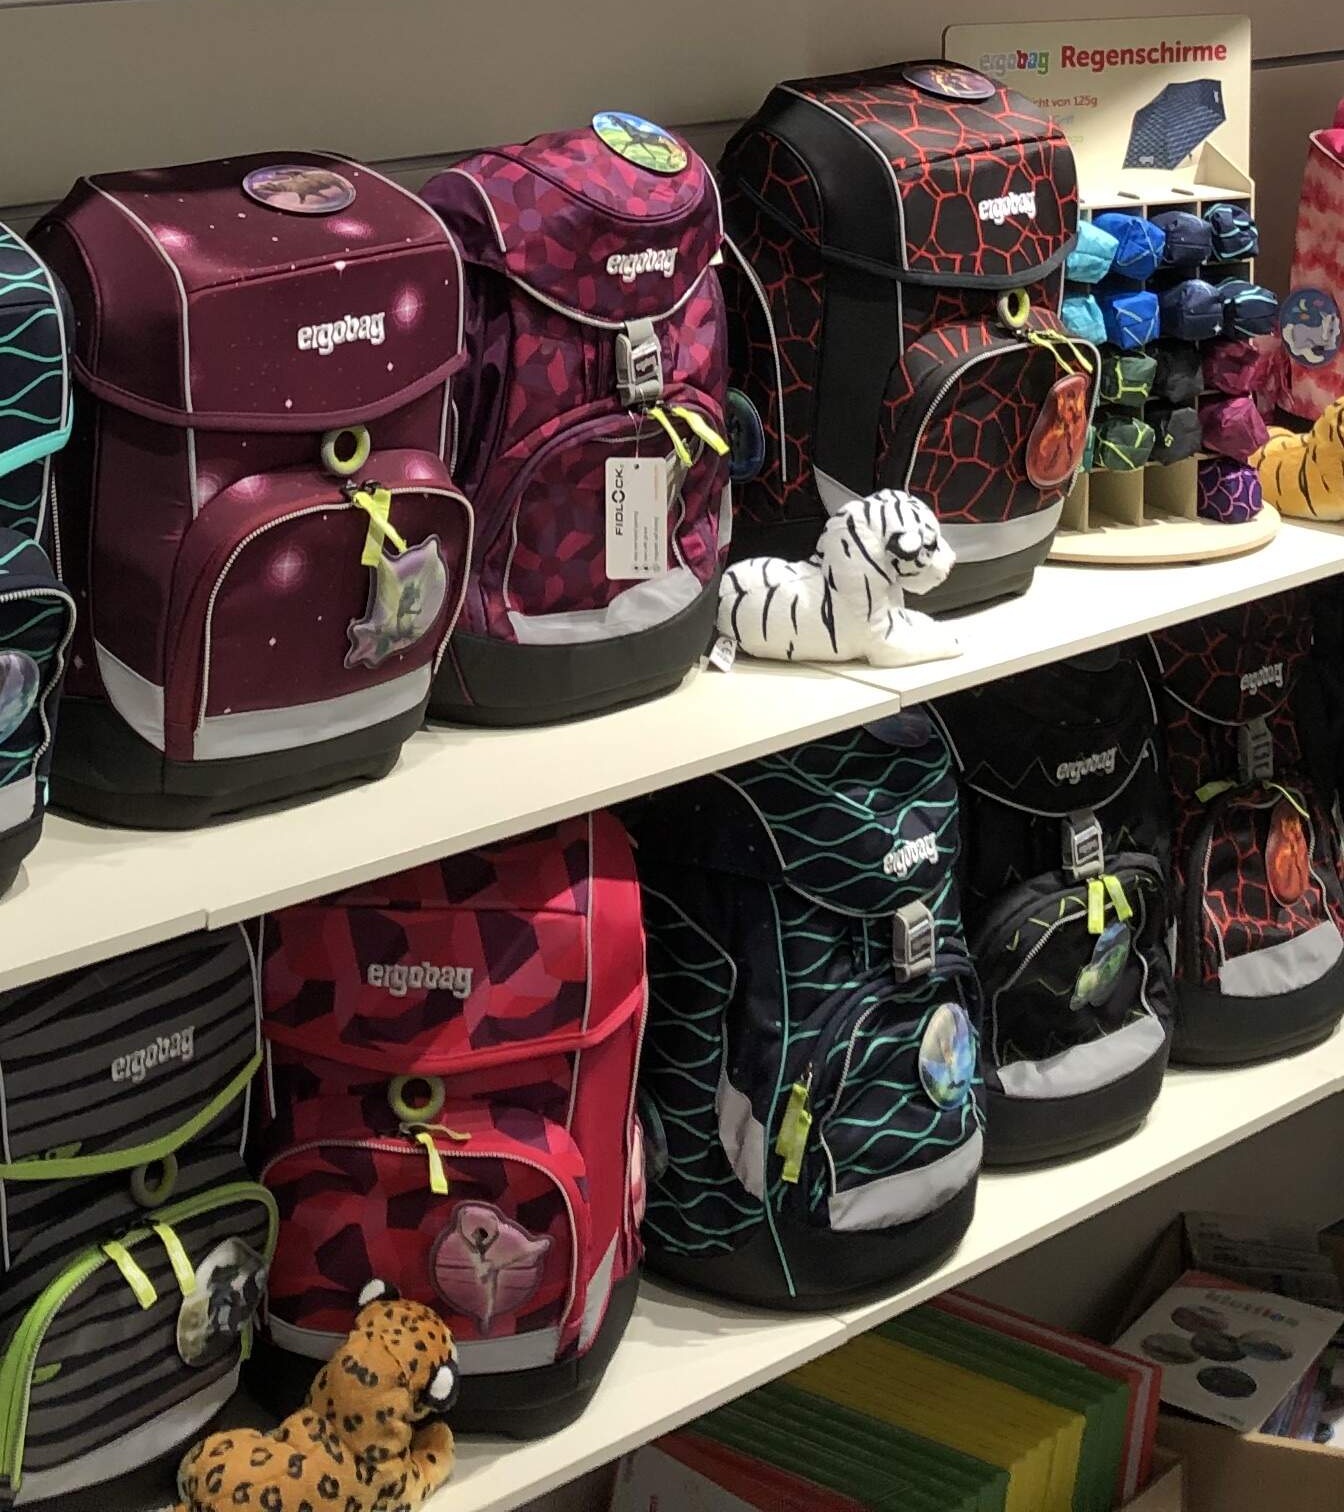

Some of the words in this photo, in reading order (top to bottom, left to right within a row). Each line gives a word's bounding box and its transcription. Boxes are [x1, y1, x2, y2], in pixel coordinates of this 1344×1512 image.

[979, 49, 1049, 75] ergobag
[1061, 41, 1227, 72] Regenschirme
[1052, 99, 1071, 107] von
[1074, 96, 1098, 107] 125g
[978, 191, 1036, 225] ergobag
[606, 247, 677, 282] ergobag
[297, 311, 385, 354] ergobag
[612, 468, 626, 536] FIDLOCK
[1239, 662, 1284, 695] ergobag
[1056, 745, 1117, 783] ergobag
[367, 960, 473, 998] ergobag
[111, 1024, 195, 1084] ergobag
